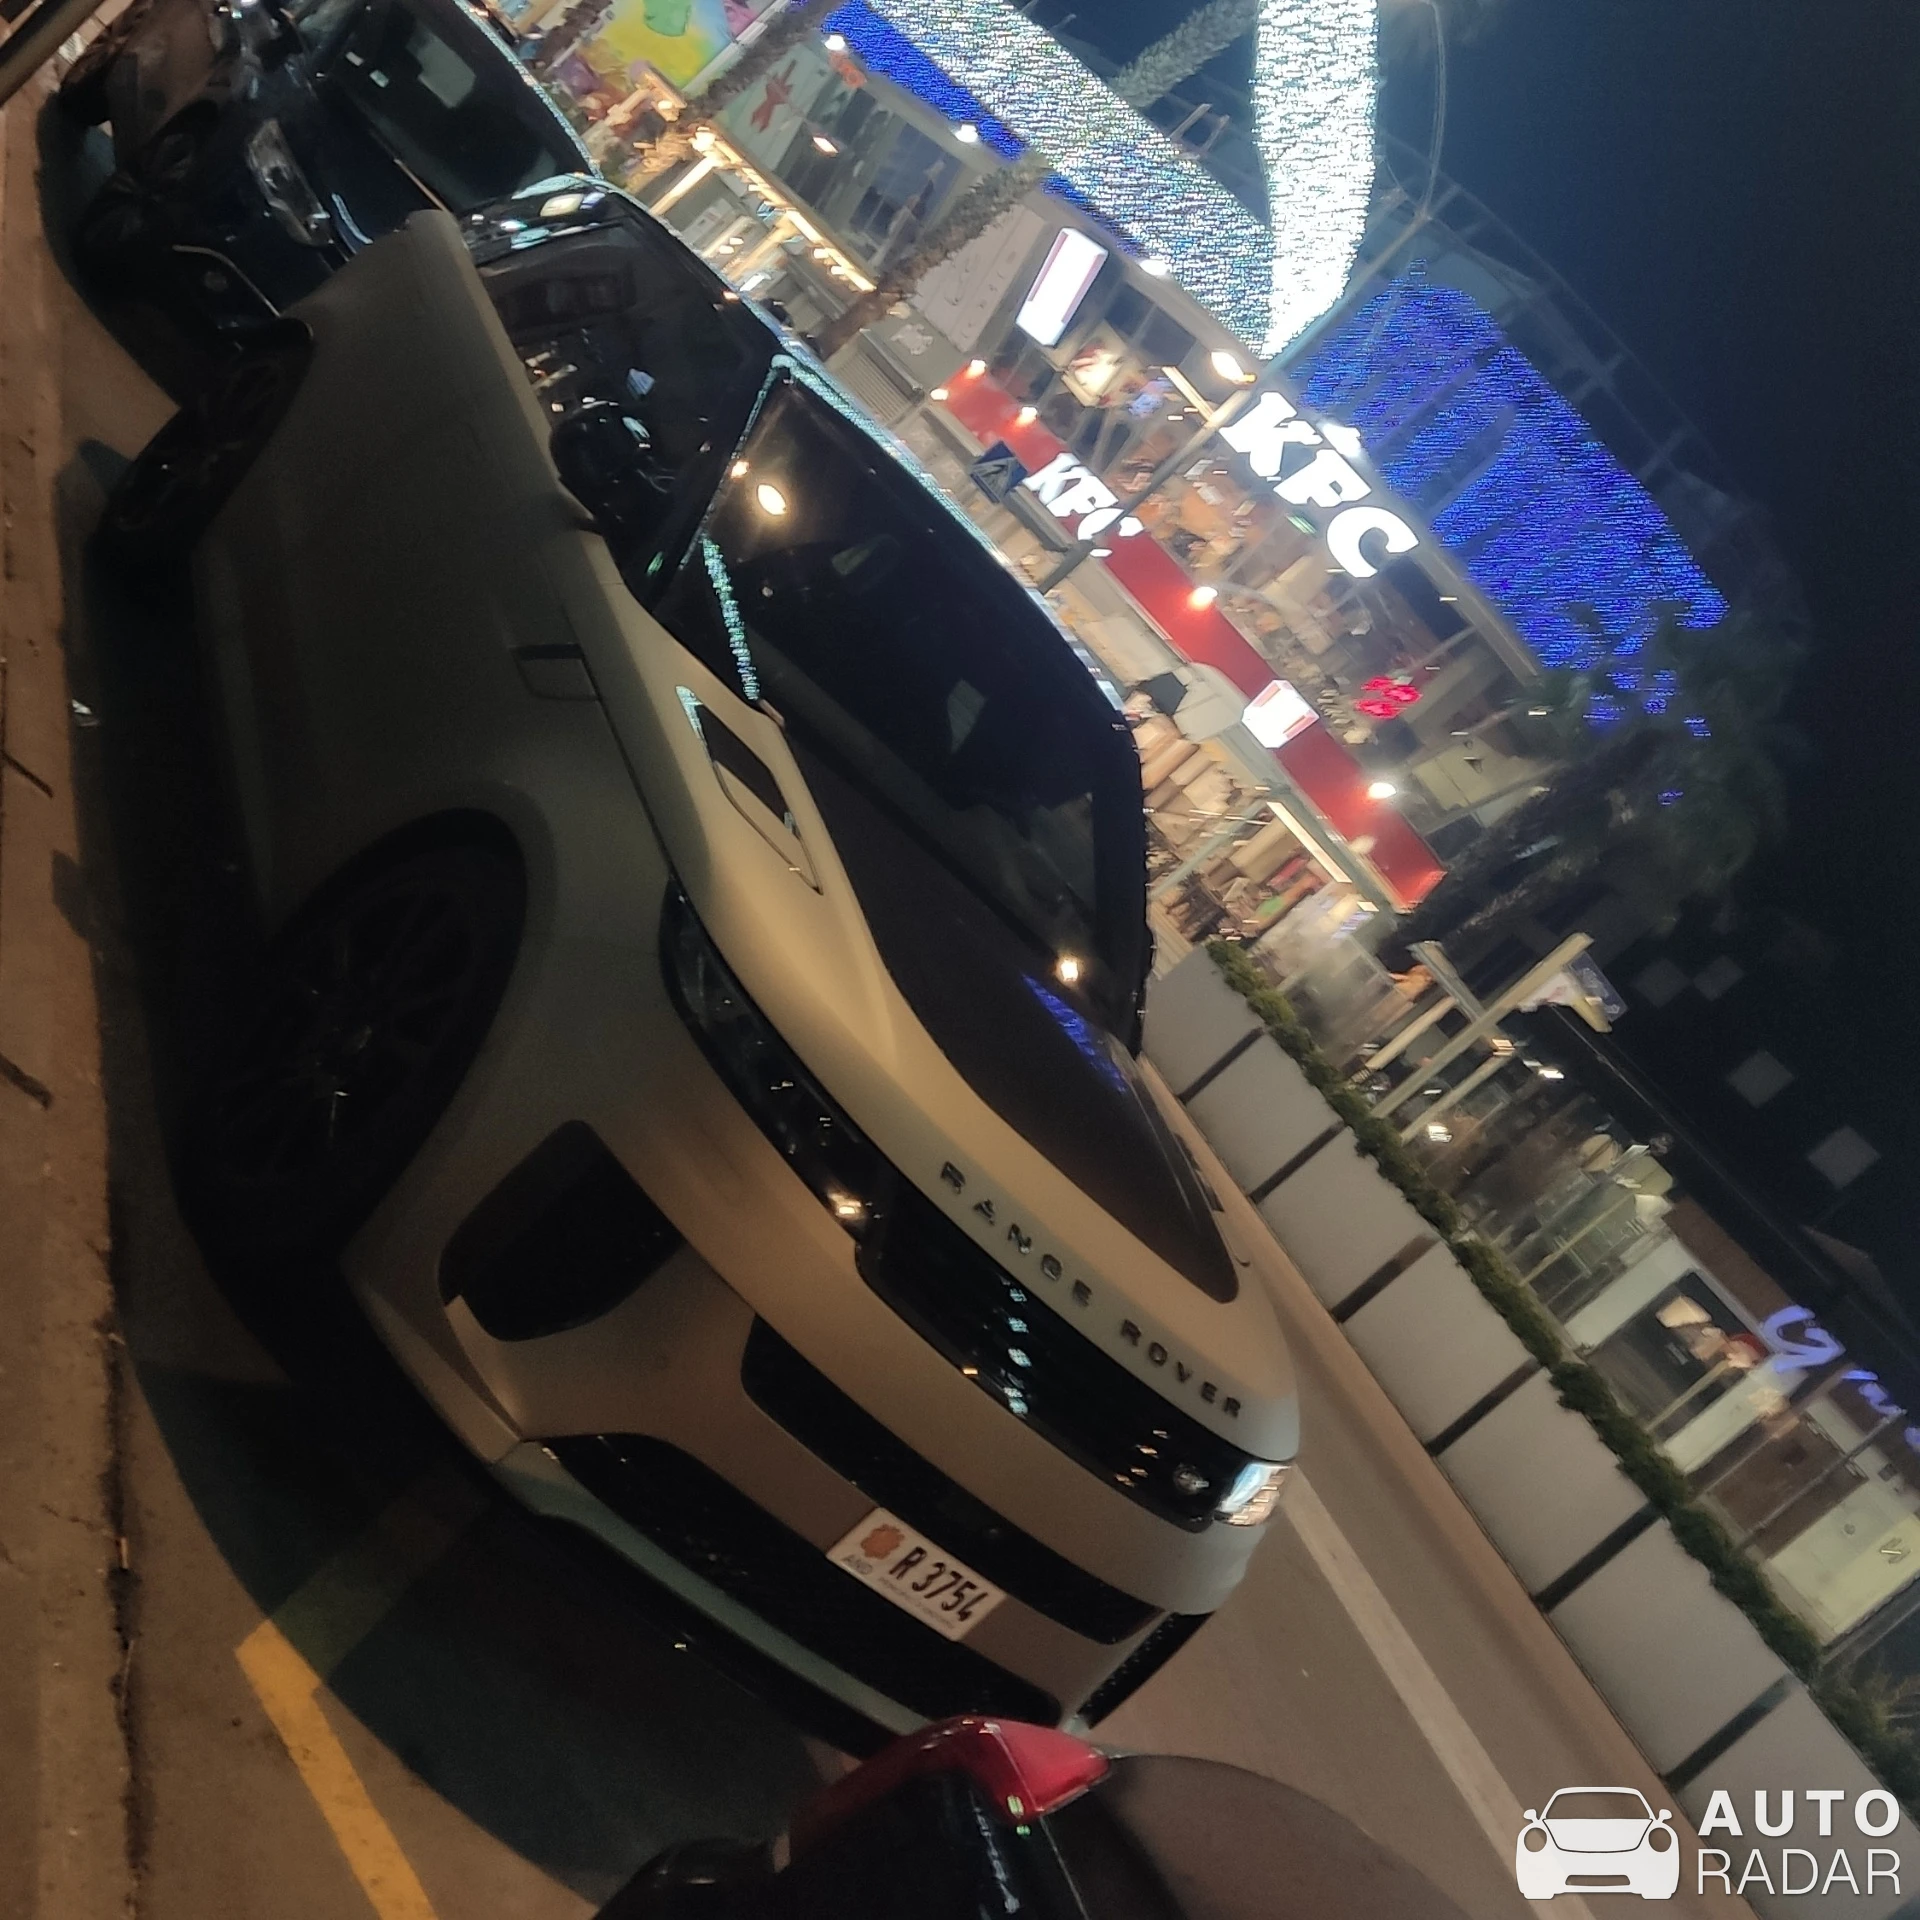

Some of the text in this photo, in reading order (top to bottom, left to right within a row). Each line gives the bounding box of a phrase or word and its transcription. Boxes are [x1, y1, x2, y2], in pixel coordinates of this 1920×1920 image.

[1022, 452, 1144, 557] KFC
[1219, 391, 1420, 578] KFC
[940, 1161, 1241, 1418] RANGE ROVER
[889, 1546, 927, 1580] R
